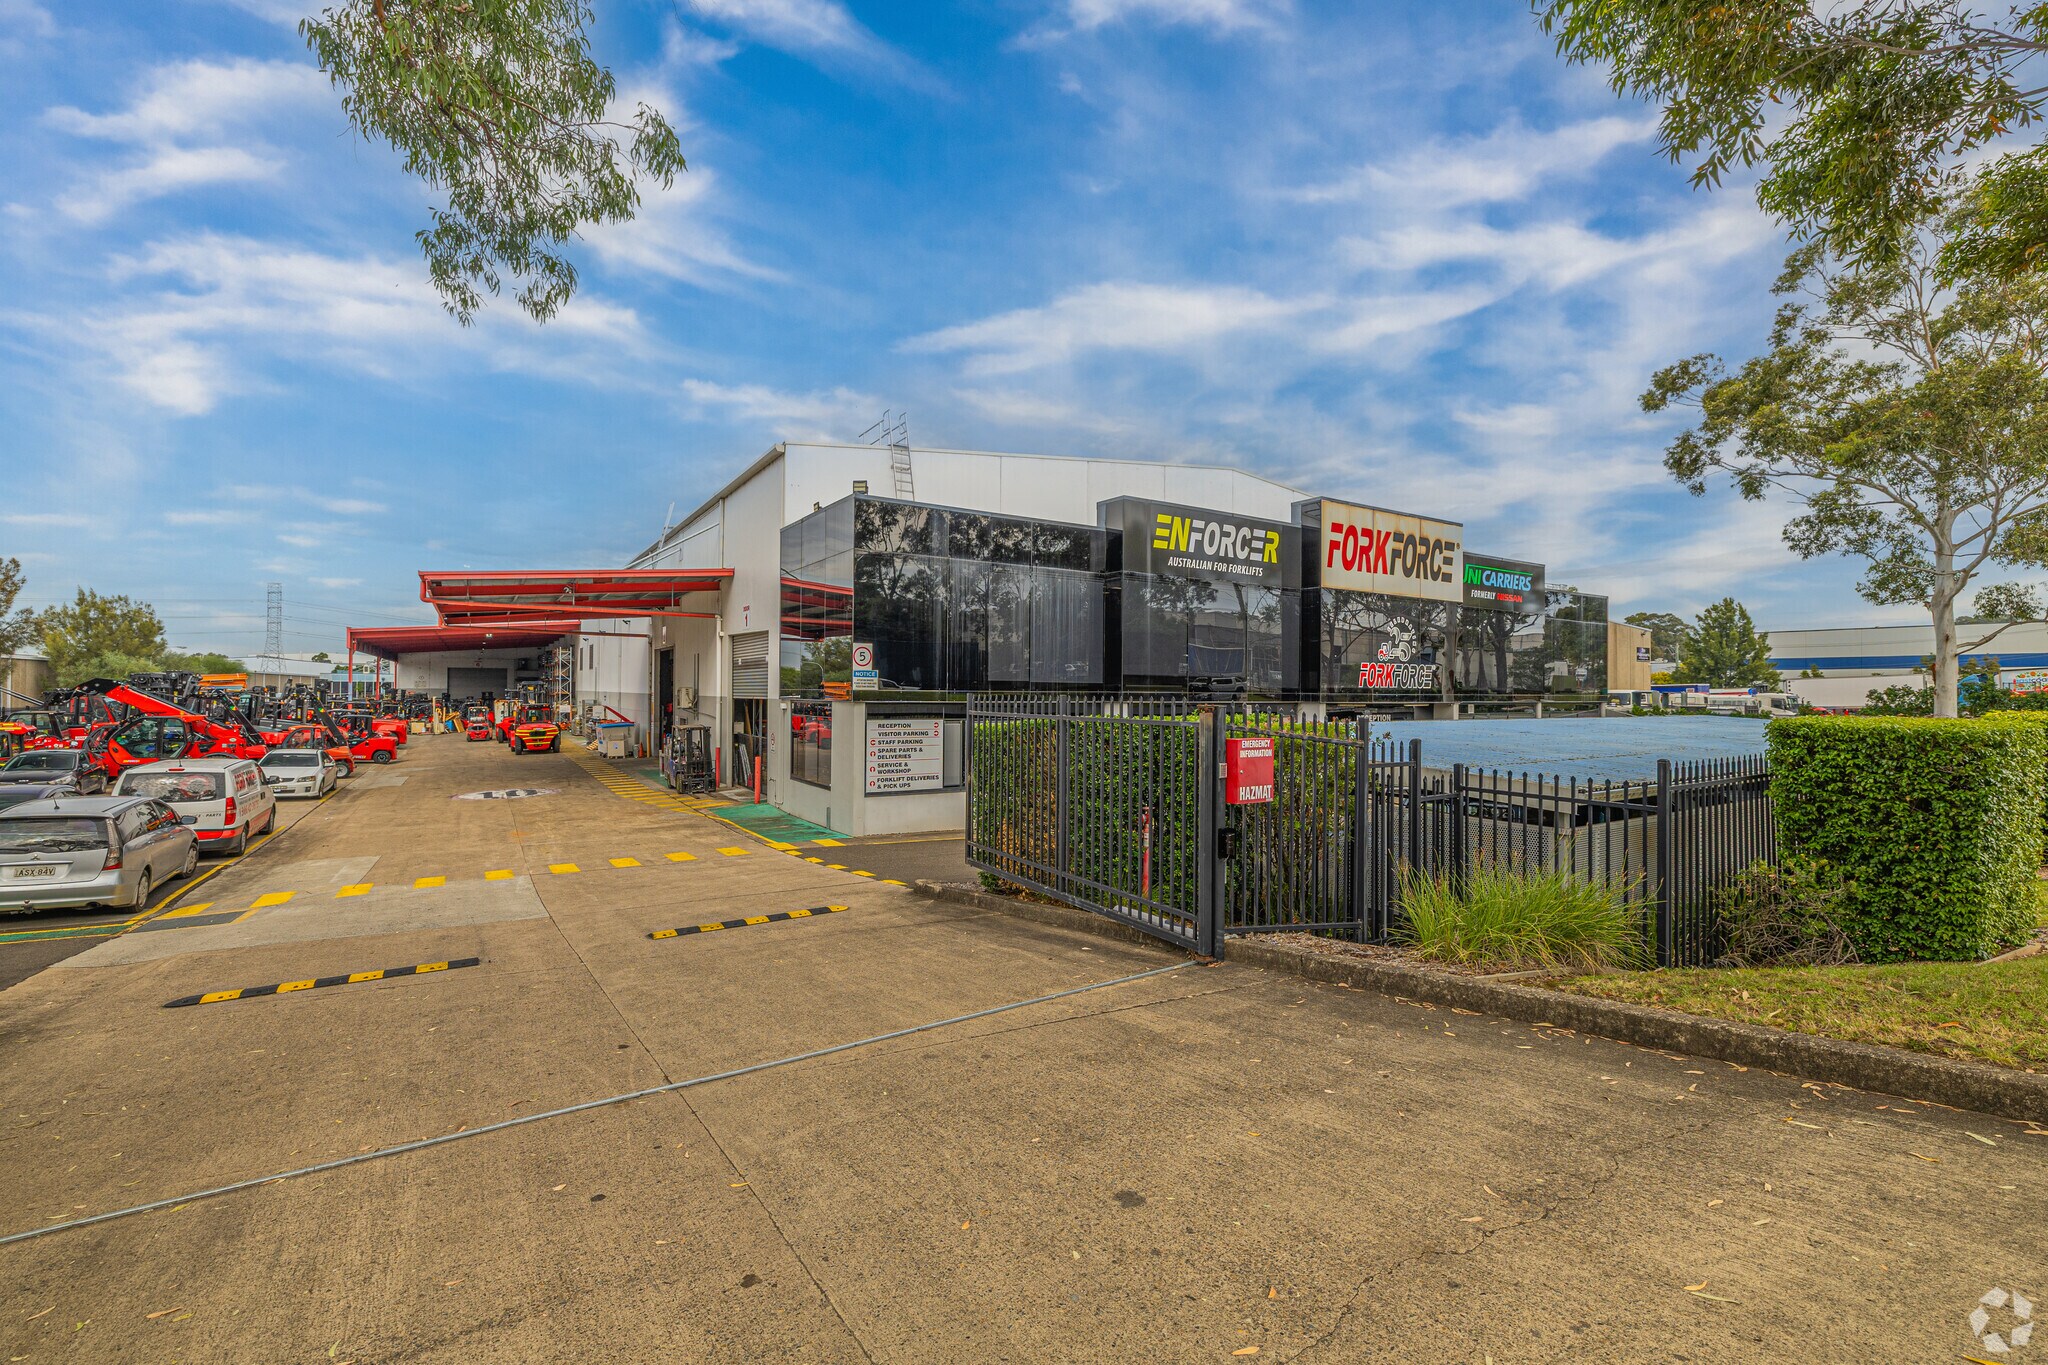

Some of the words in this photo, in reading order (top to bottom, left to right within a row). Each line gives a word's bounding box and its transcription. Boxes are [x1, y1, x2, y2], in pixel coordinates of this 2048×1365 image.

[1153, 514, 1280, 563] ENFORCER
[1327, 522, 1455, 583] FORKFORCE
[1168, 557, 1212, 571] AUSTRALIAN
[1213, 562, 1227, 572] FOR
[1228, 564, 1263, 577] FORKLIFTS
[1471, 590, 1496, 600] FORMERLY
[1497, 592, 1523, 603] NISSAN
[859, 651, 866, 662] 5
[1359, 662, 1433, 688] FORKFORCE
[1241, 739, 1271, 748] EMERGENCY
[1240, 749, 1273, 758] INFORMATION
[1240, 785, 1272, 800] HAZMAT
